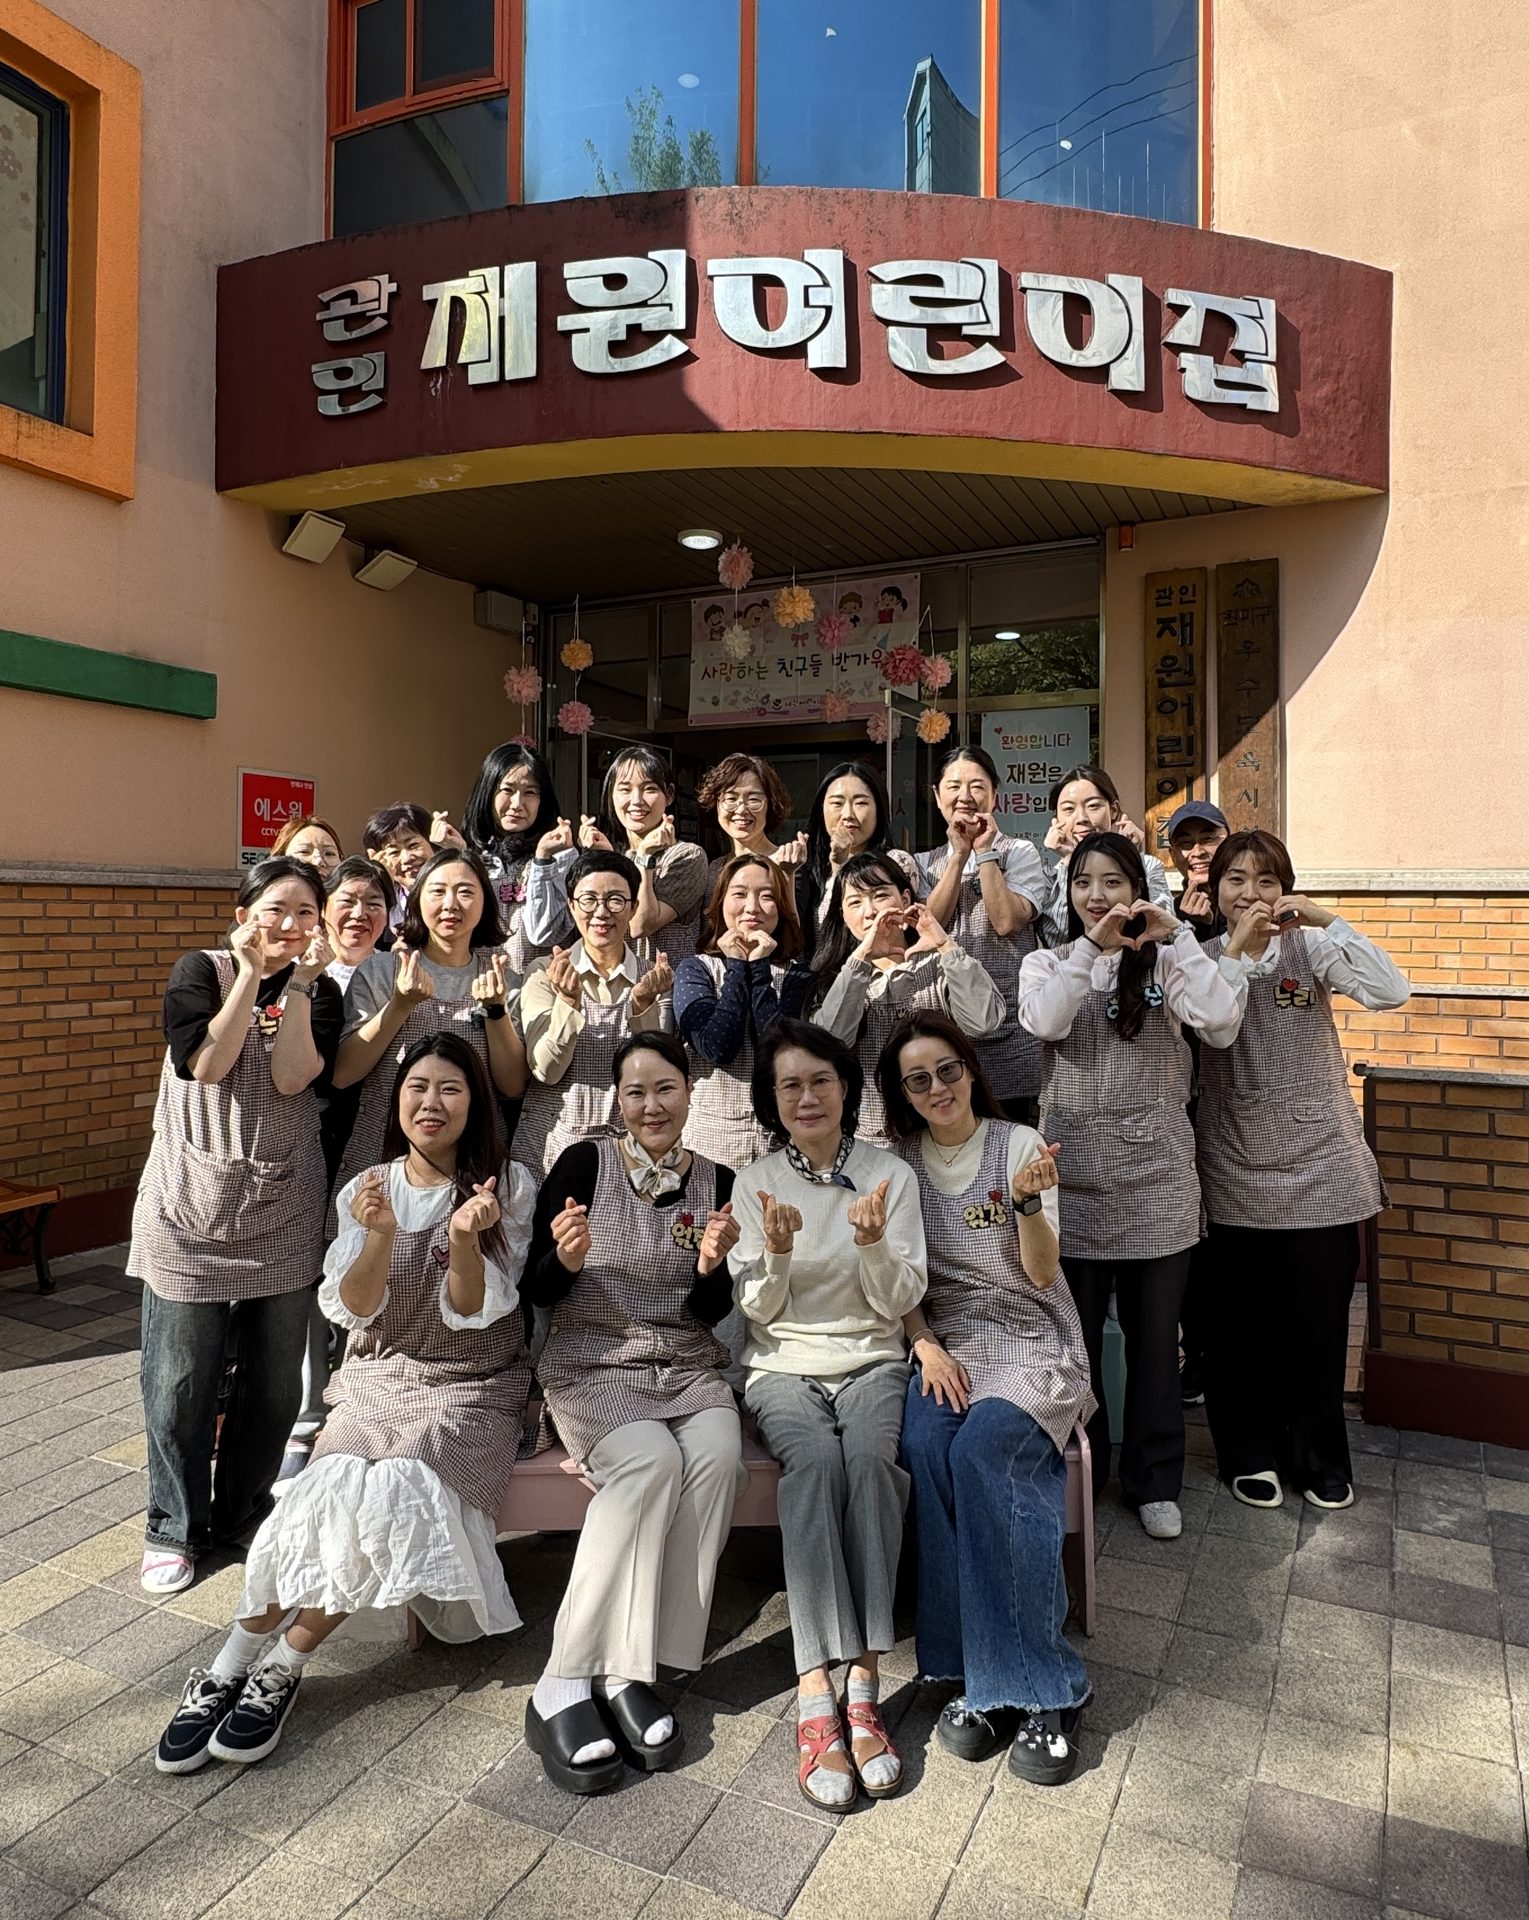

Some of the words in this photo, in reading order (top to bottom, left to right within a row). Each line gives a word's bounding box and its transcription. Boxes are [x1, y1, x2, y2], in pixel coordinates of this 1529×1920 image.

[420, 248, 1281, 414] 재원어린이집
[312, 273, 399, 417] 관인
[1154, 584, 1197, 608] 관인
[701, 661, 769, 682] 사랑하는
[776, 653, 823, 678] 친구들
[1001, 733, 1071, 750] 환영합니다
[1235, 639, 1261, 832] 우수보육시
[1006, 762, 1062, 784] 재원은
[992, 792, 1048, 814] 사랑입
